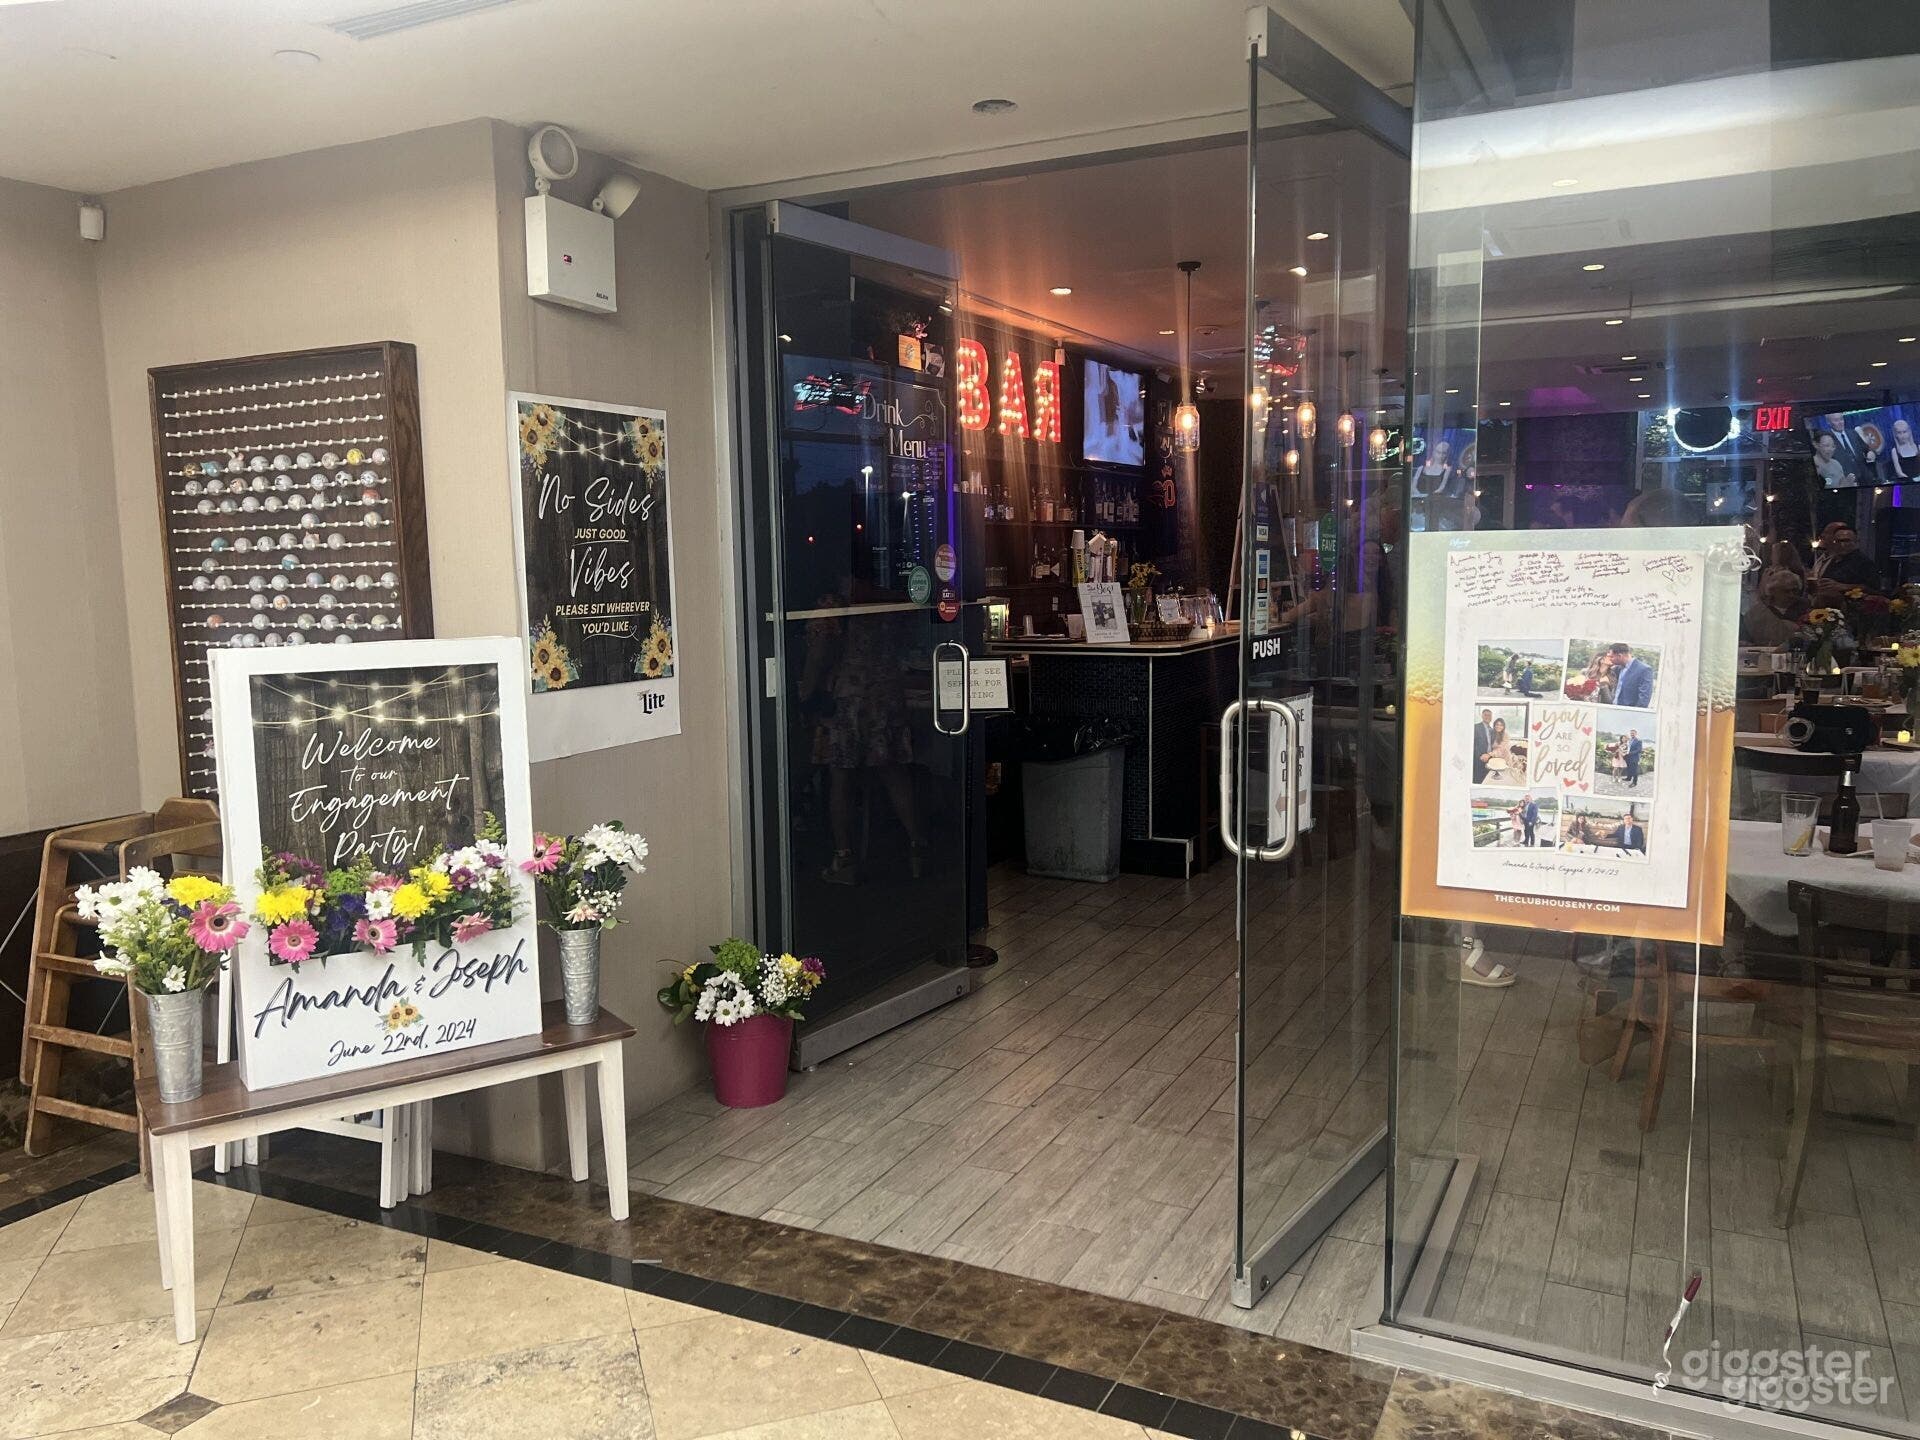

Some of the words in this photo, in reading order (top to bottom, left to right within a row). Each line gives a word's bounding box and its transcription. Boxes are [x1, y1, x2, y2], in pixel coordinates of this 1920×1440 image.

[959, 337, 1061, 442] BAR
[863, 394, 903, 426] Drink
[1756, 406, 1792, 430] EXIT
[889, 428, 928, 459] Menu
[538, 473, 575, 520] No
[584, 476, 655, 525] Sides
[574, 528, 597, 539] JUST
[600, 529, 626, 539] GOOD
[570, 546, 634, 598] Vibes
[555, 604, 589, 616] PLEASE
[591, 603, 605, 614] SIT
[606, 601, 650, 613] WHEREVER
[582, 621, 610, 635] YOU'D
[611, 621, 629, 632] LIKE
[1252, 637, 1281, 660] PUSH
[984, 667, 1001, 675] SEE
[641, 692, 665, 714] Lite
[1540, 709, 1588, 740] you
[1555, 732, 1572, 740] ARE
[301, 727, 440, 770] Welcome
[1534, 741, 1592, 783] loved
[1556, 744, 1570, 752] SO
[340, 764, 366, 791] to
[370, 769, 398, 780] our
[288, 773, 470, 834] Engagement
[332, 825, 424, 866] Party!
[1494, 894, 1621, 913] THECLUBHOUSENY.COM
[253, 963, 408, 1038] Amanda
[414, 975, 426, 994] &
[428, 938, 529, 999] Joseph
[327, 1040, 375, 1067] June
[381, 1024, 428, 1055] 22nd,
[434, 1018, 477, 1045] 2024
